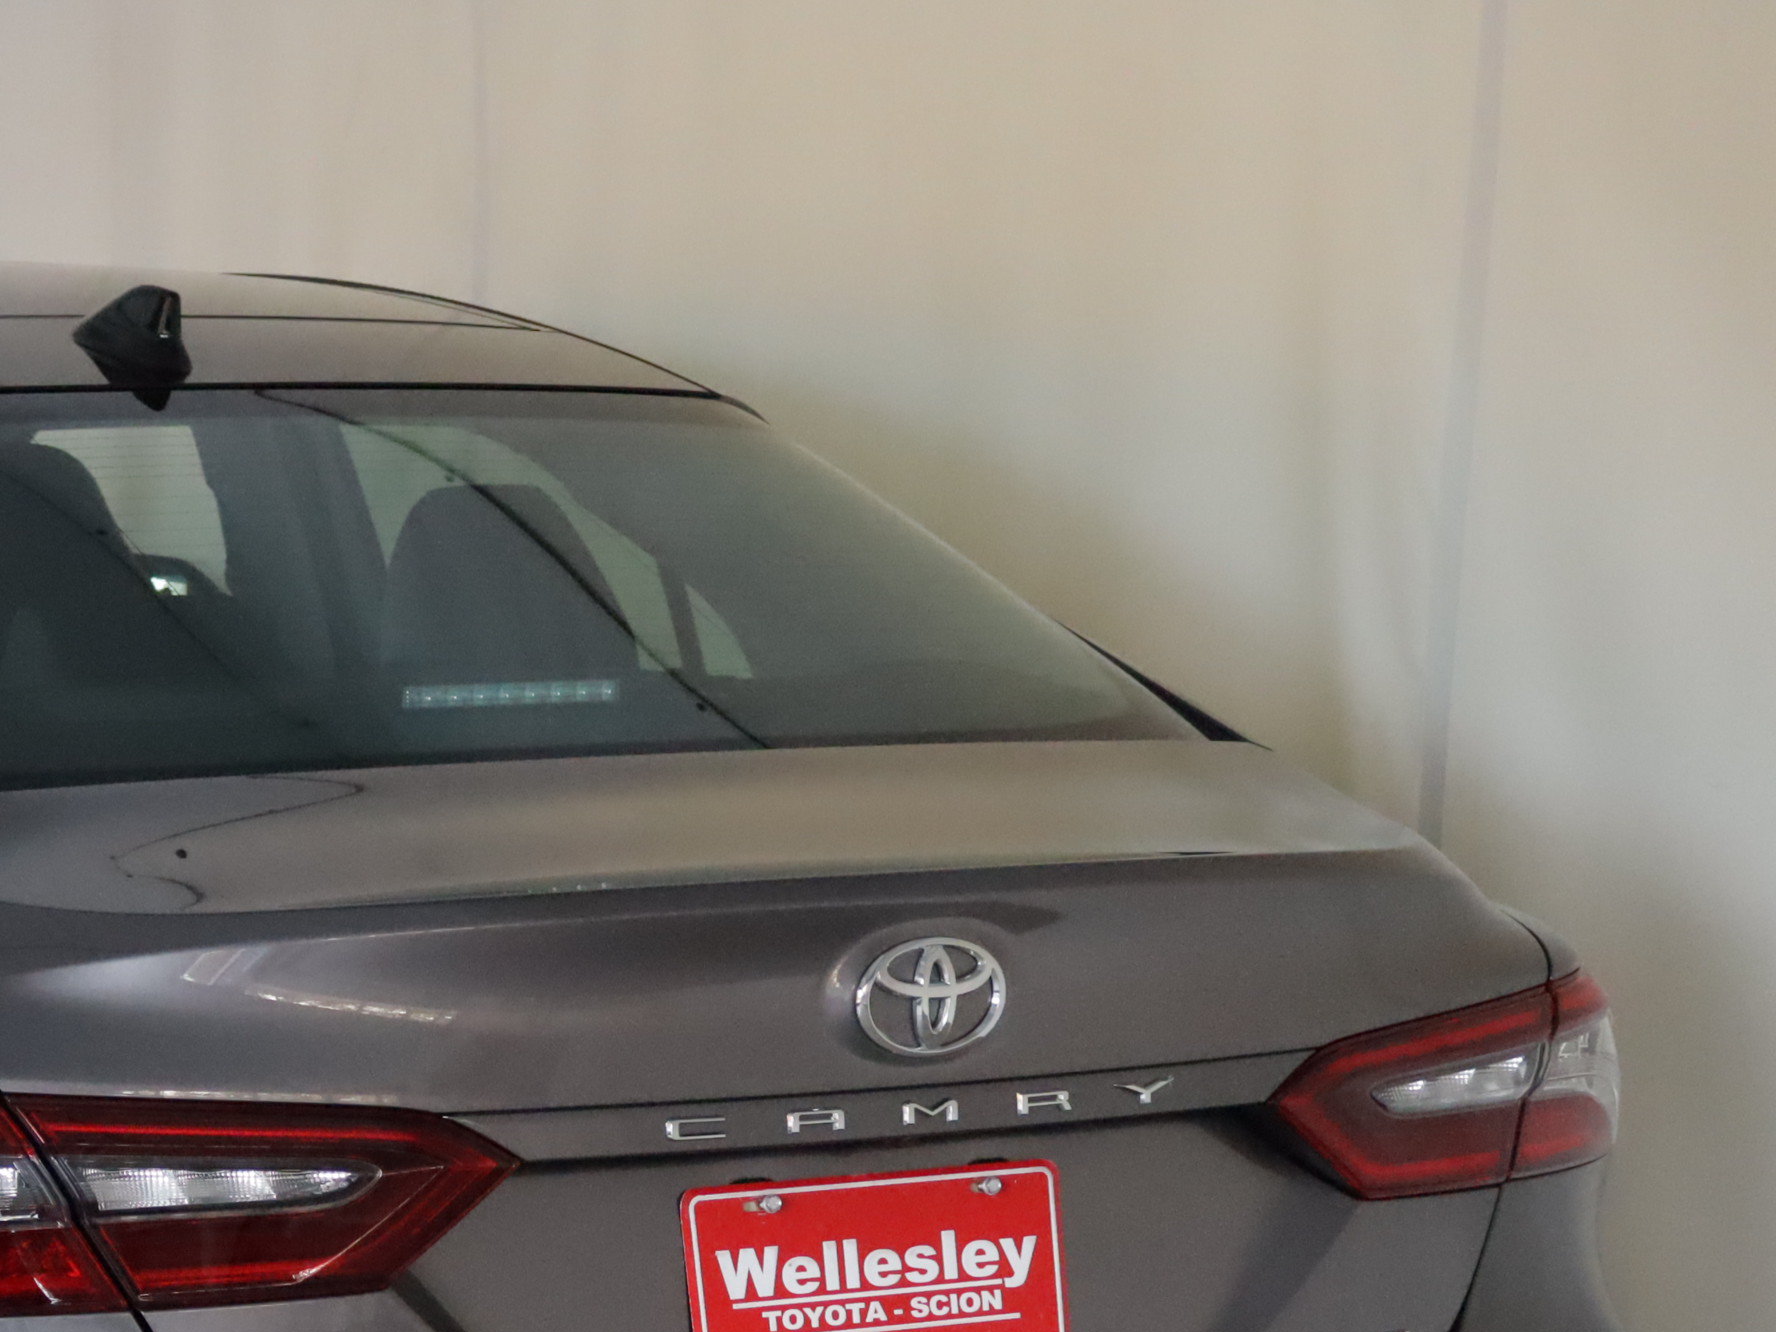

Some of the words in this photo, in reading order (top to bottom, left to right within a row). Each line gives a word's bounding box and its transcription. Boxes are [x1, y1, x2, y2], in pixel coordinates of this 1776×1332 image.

[665, 1075, 1174, 1140] CAMRY
[715, 1229, 1037, 1300] Wellesley
[762, 1300, 887, 1332] TOYOTA
[910, 1289, 1003, 1317] SCION
